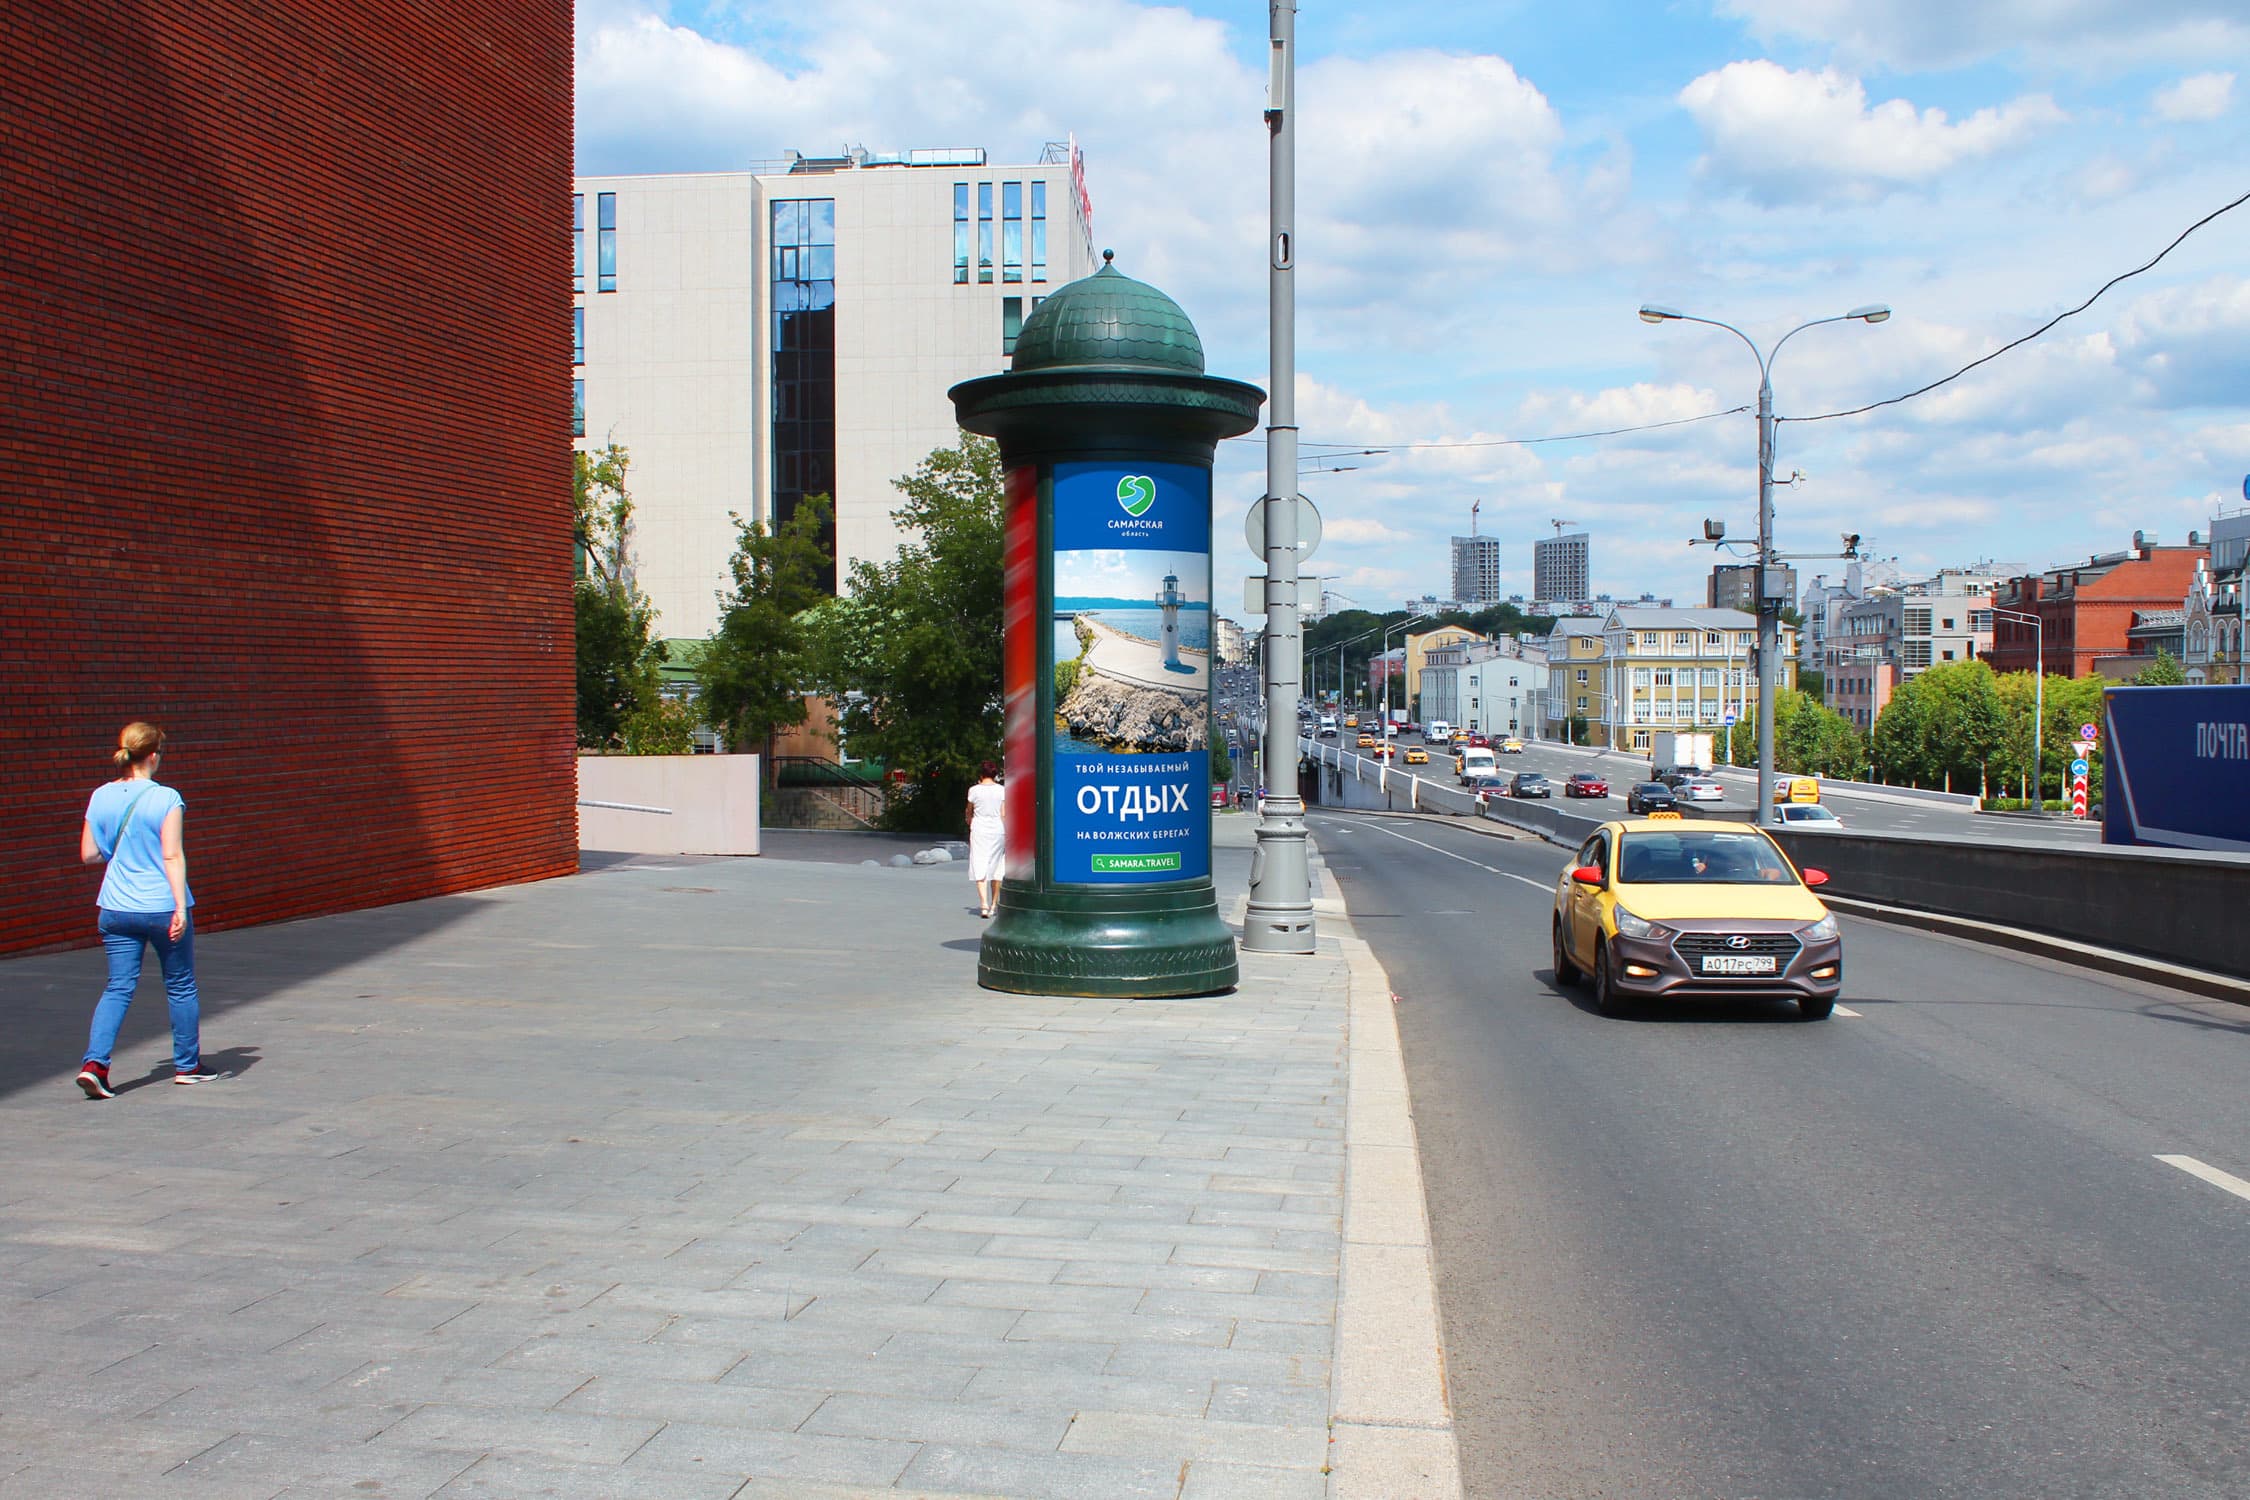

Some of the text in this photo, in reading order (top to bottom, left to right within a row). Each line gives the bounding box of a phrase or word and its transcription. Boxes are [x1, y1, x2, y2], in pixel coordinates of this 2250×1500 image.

[1107, 520, 1163, 529] САМАРСКАЯ
[2196, 722, 2249, 760] ПОЧТА
[1075, 761, 1190, 774] ТВОЙ НЕЗАБЫВАЕМЫЙ
[1076, 783, 1190, 822] ОТДЫХ
[1077, 828, 1190, 840] НА ВОЛЖСКИХ БЕРЕГАХ
[1109, 857, 1175, 868] SAMARA.TRAVEL
